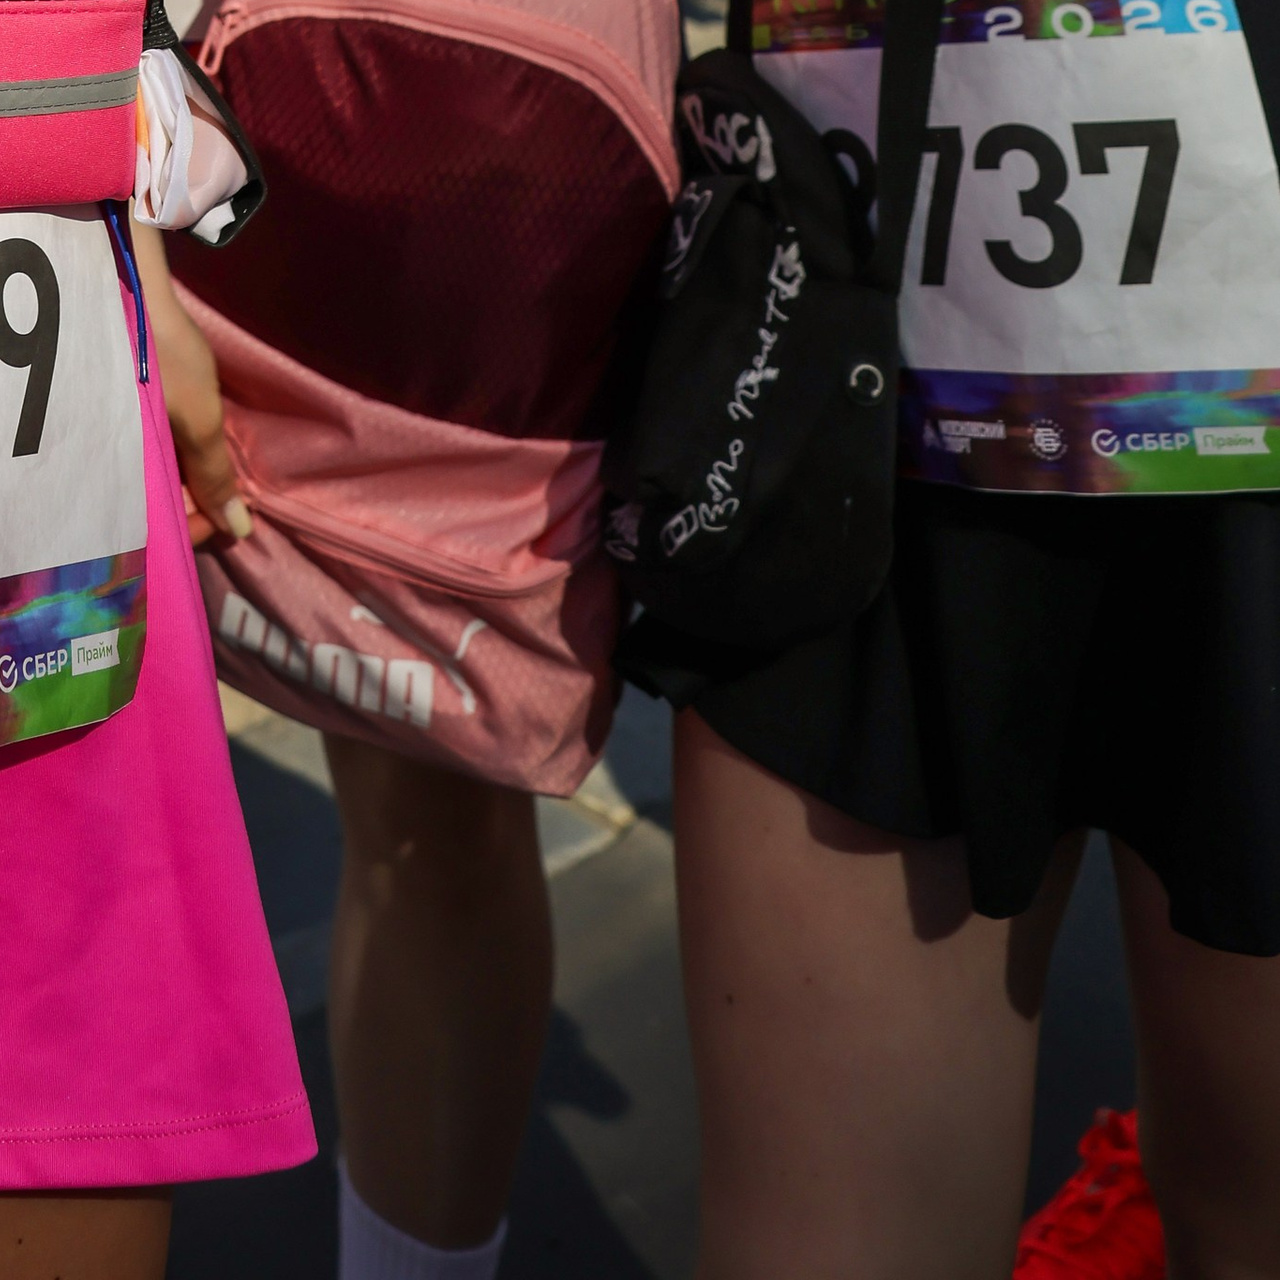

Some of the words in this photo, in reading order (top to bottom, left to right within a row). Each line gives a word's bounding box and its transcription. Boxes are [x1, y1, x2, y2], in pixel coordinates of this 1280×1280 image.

[1125, 432, 1190, 452] СБЕР
[22, 648, 68, 681] СБЕР
[77, 641, 113, 666] Прайм
